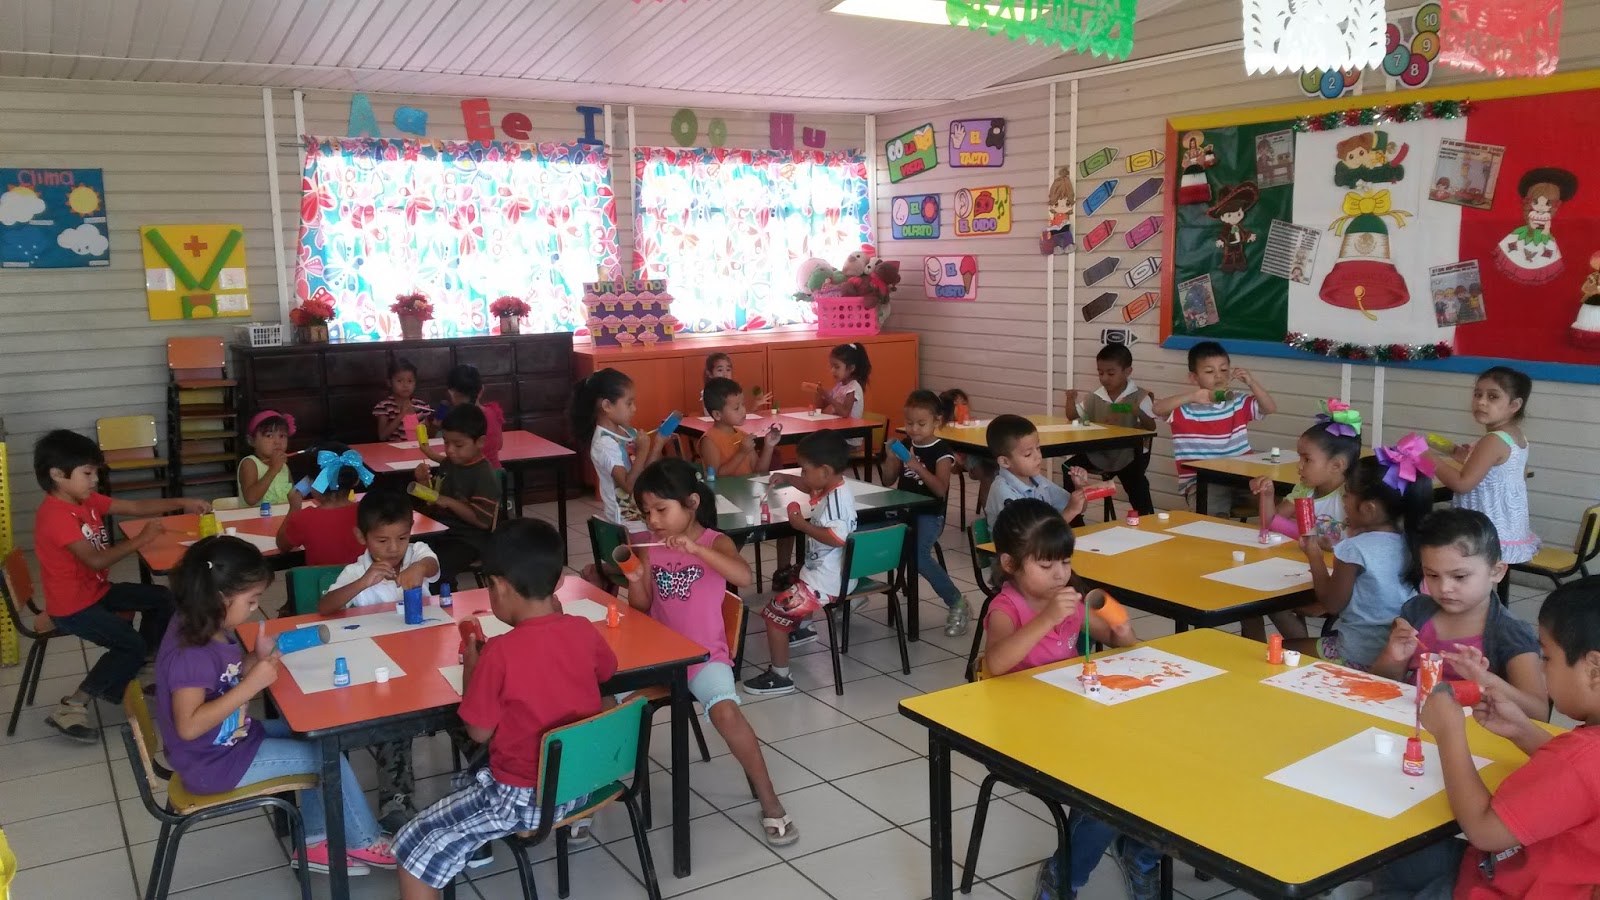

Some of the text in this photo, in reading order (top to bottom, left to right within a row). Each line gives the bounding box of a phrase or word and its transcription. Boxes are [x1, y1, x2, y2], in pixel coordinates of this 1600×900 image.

[1423, 13, 1438, 26] 10
[1423, 39, 1432, 52] 9
[1393, 54, 1401, 67] 7
[1410, 63, 1419, 76] 8
[1310, 74, 1316, 85] 1
[1328, 77, 1336, 89] 2
[970, 131, 981, 144] EL
[904, 141, 917, 156] LA
[960, 152, 990, 165] TACTO
[900, 158, 925, 177] VISTA
[910, 202, 920, 215] EL
[902, 224, 933, 237] OLFATO
[958, 218, 997, 233] EL OIDO
[945, 263, 957, 276] EL
[935, 285, 966, 298] GUSTO
